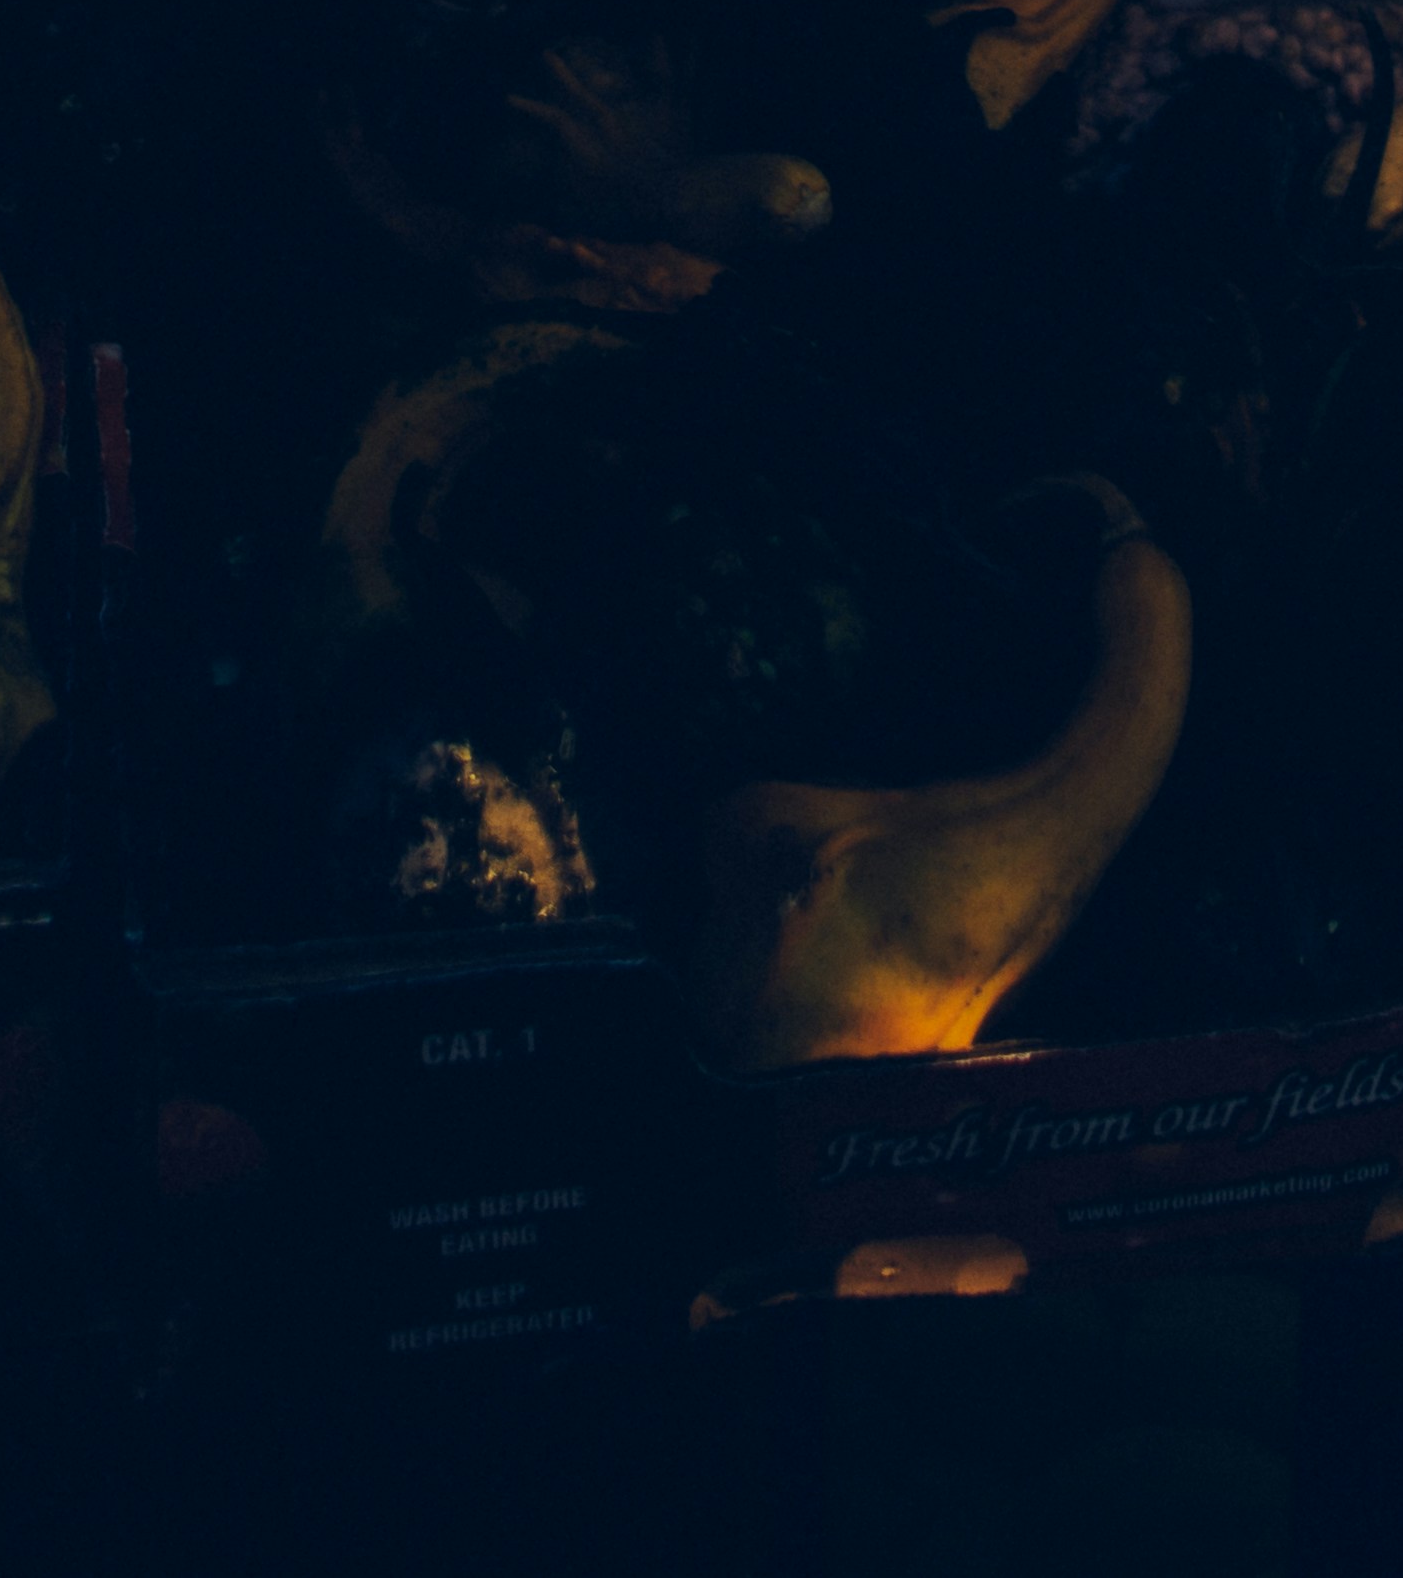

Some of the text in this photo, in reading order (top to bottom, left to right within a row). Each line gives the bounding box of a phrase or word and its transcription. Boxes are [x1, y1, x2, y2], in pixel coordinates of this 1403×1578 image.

[419, 1023, 538, 1068] CAT. 1
[820, 1111, 985, 1185] Fresh
[993, 1096, 1134, 1175] from
[1150, 1095, 1248, 1145] our
[387, 1183, 590, 1233] WASH BEFORE
[439, 1221, 541, 1259] EATING
[453, 1278, 530, 1312] KEEP
[387, 1303, 598, 1354] REFRIGERATED
